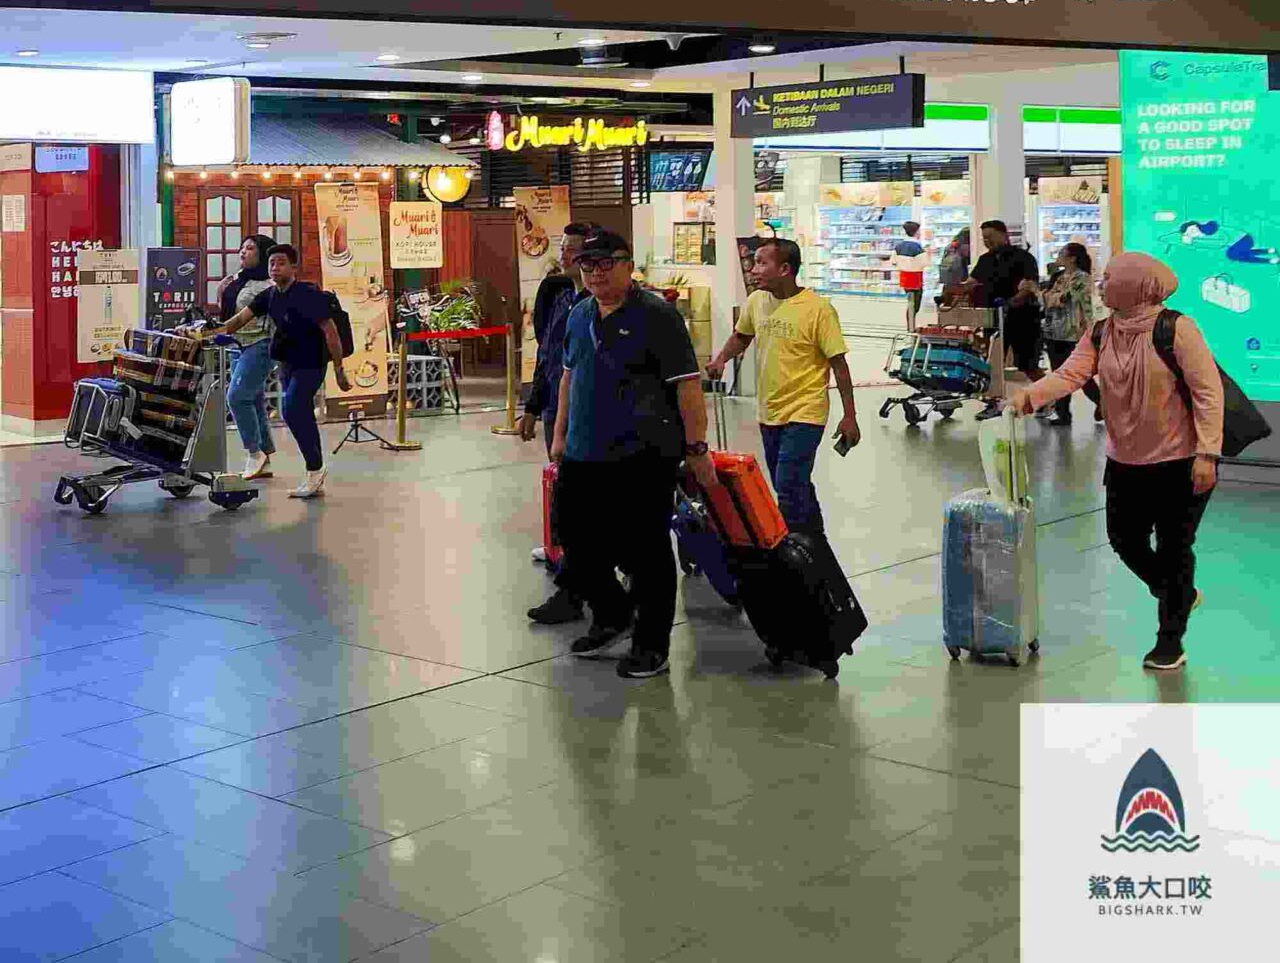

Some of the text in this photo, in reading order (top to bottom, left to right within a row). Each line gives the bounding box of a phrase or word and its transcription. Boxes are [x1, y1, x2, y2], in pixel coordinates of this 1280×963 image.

[819, 86, 854, 99] DALAM
[856, 83, 894, 96] NEGERI
[772, 101, 841, 115] Domestic Arrivals
[1137, 100, 1256, 117] LOOKING FOR
[1137, 118, 1254, 134] A GOOD SPOT
[1137, 135, 1242, 152] TO SLEEP IN
[1138, 154, 1226, 169] AIRPORT?
[393, 209, 429, 227] Muari
[406, 222, 439, 239] Muari
[152, 290, 195, 304] TORII
